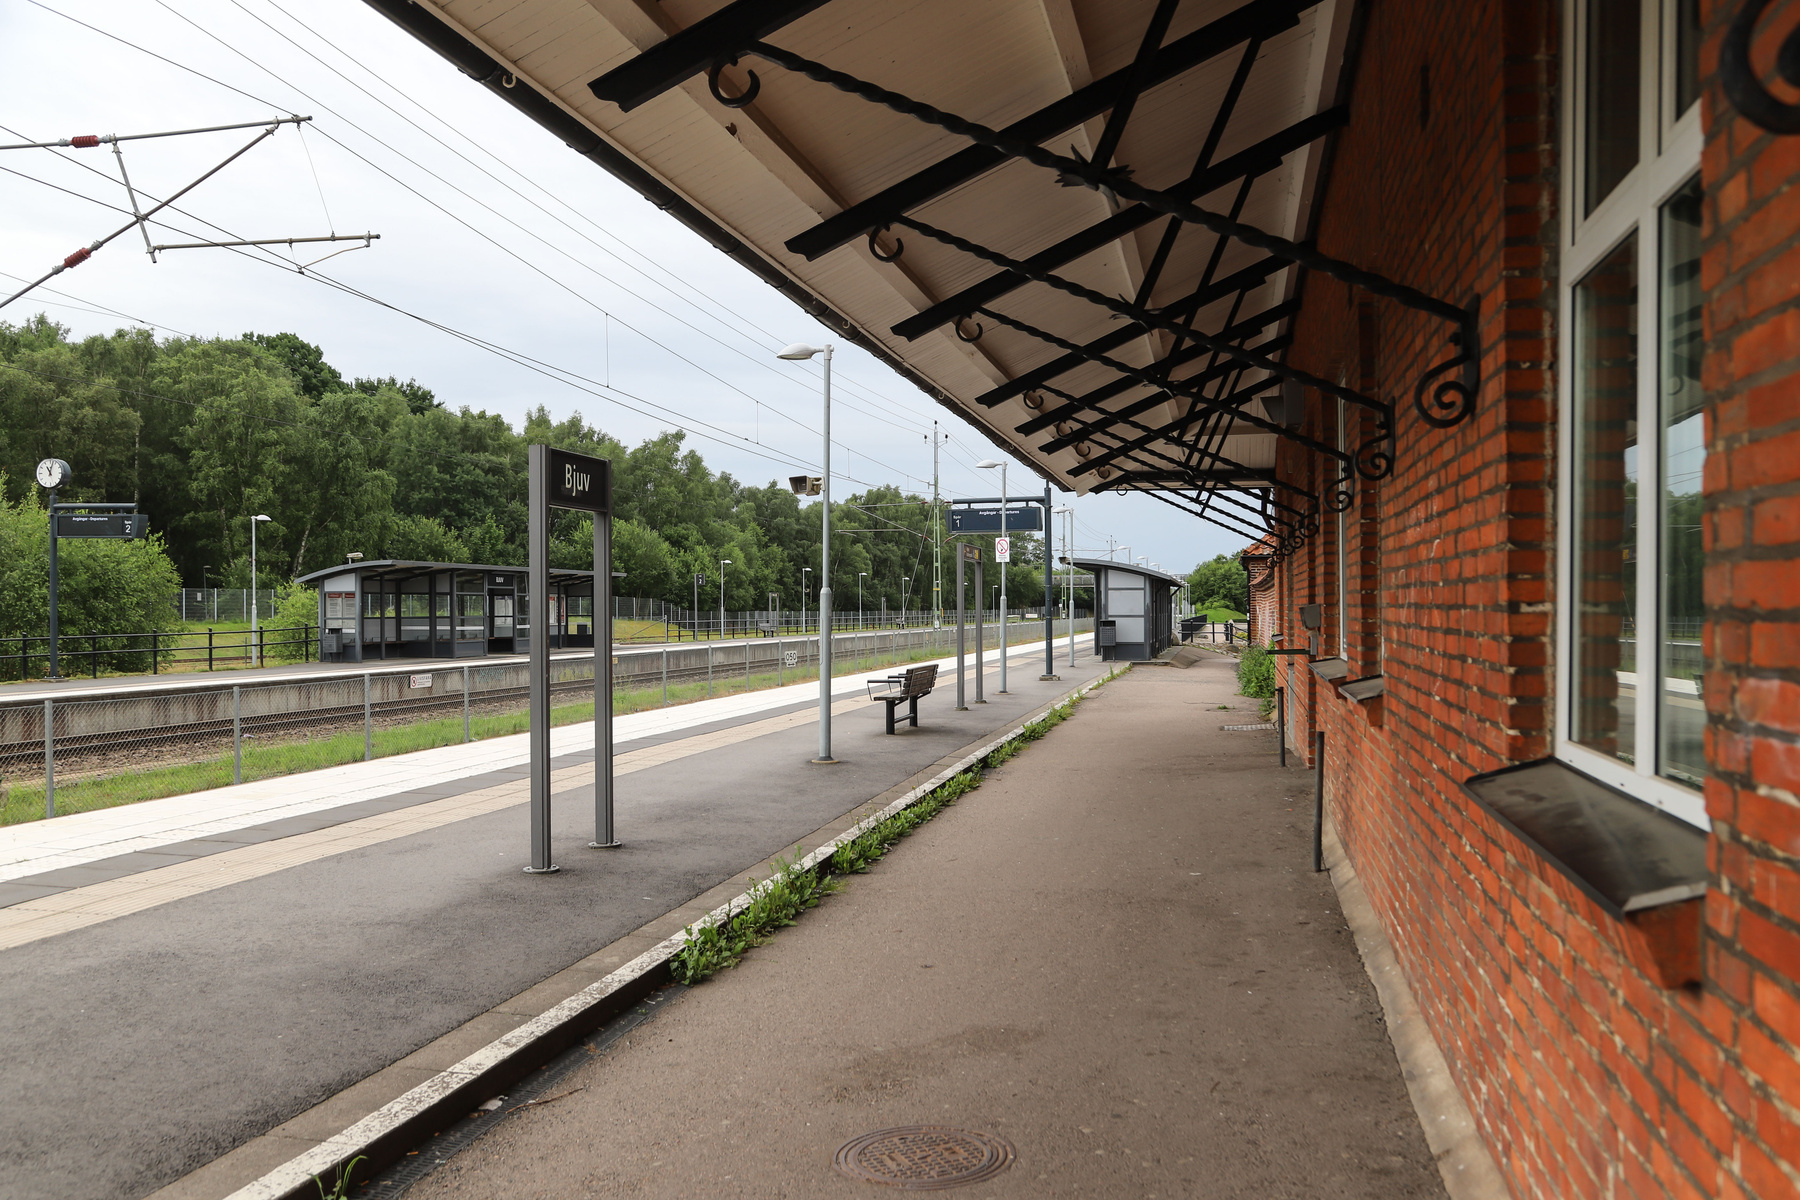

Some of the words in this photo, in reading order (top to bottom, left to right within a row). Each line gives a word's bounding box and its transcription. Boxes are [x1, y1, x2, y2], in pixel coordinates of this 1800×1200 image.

[565, 463, 590, 497] Bjuv
[126, 524, 131, 533] 2
[956, 520, 960, 528] 1
[786, 652, 796, 661] 050
